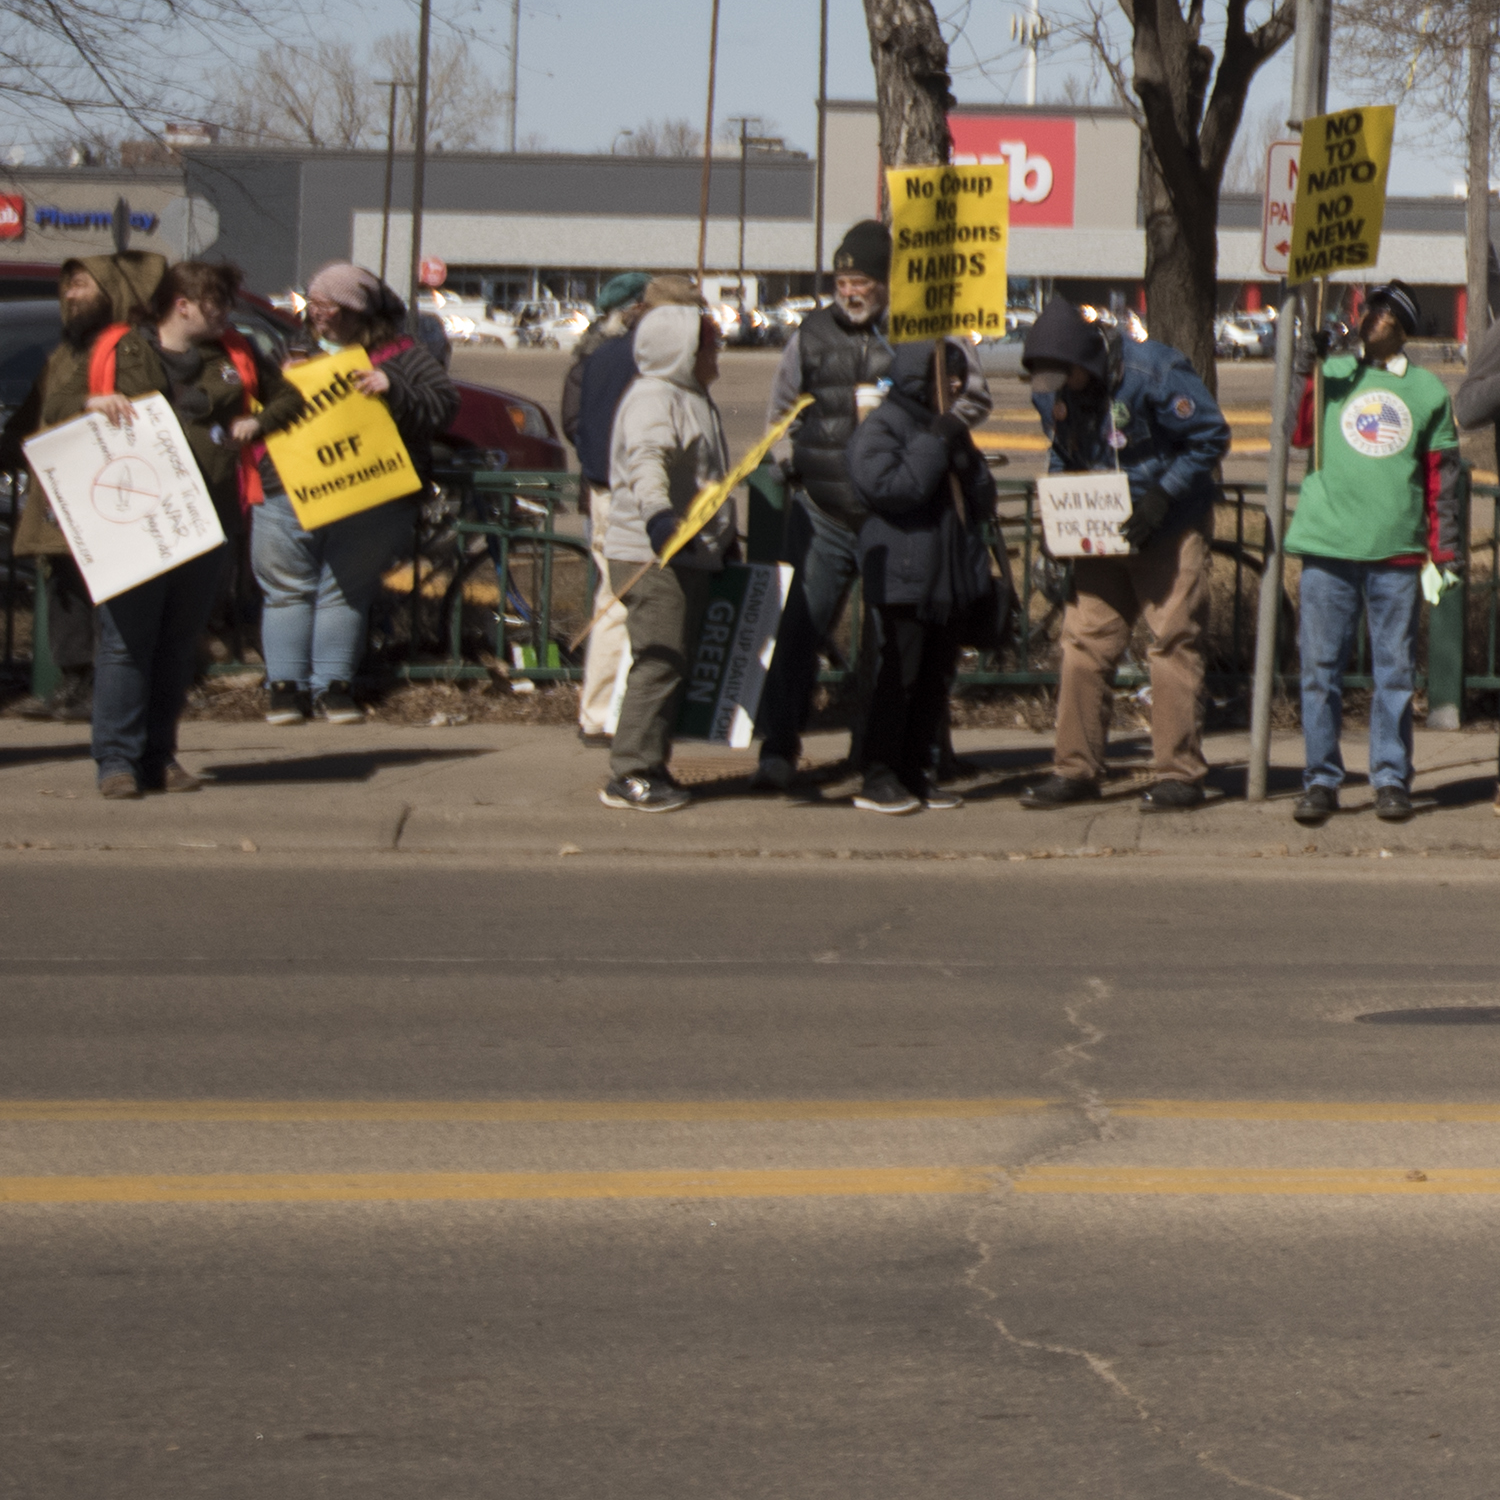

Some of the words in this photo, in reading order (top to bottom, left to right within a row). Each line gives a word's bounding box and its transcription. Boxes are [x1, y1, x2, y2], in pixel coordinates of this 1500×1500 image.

[1325, 112, 1363, 141] NO
[1325, 138, 1356, 165] TO
[906, 176, 934, 199] No
[940, 173, 993, 198] Coup
[1307, 160, 1377, 195] NATO
[35, 206, 156, 231] Pharmcy
[935, 199, 958, 221] No
[1317, 194, 1353, 224] NO
[898, 222, 1001, 250] Sanctions
[1305, 218, 1365, 250] NEW
[907, 251, 986, 283] HANDS
[1294, 242, 1369, 278] WARS
[924, 282, 963, 310] OFF
[892, 307, 999, 337] Venezuela
[286, 369, 360, 434] ands
[317, 434, 363, 467] OFF
[294, 452, 406, 504] Venezuela!
[1056, 521, 1083, 537] FOR
[687, 600, 735, 703] GREEN
